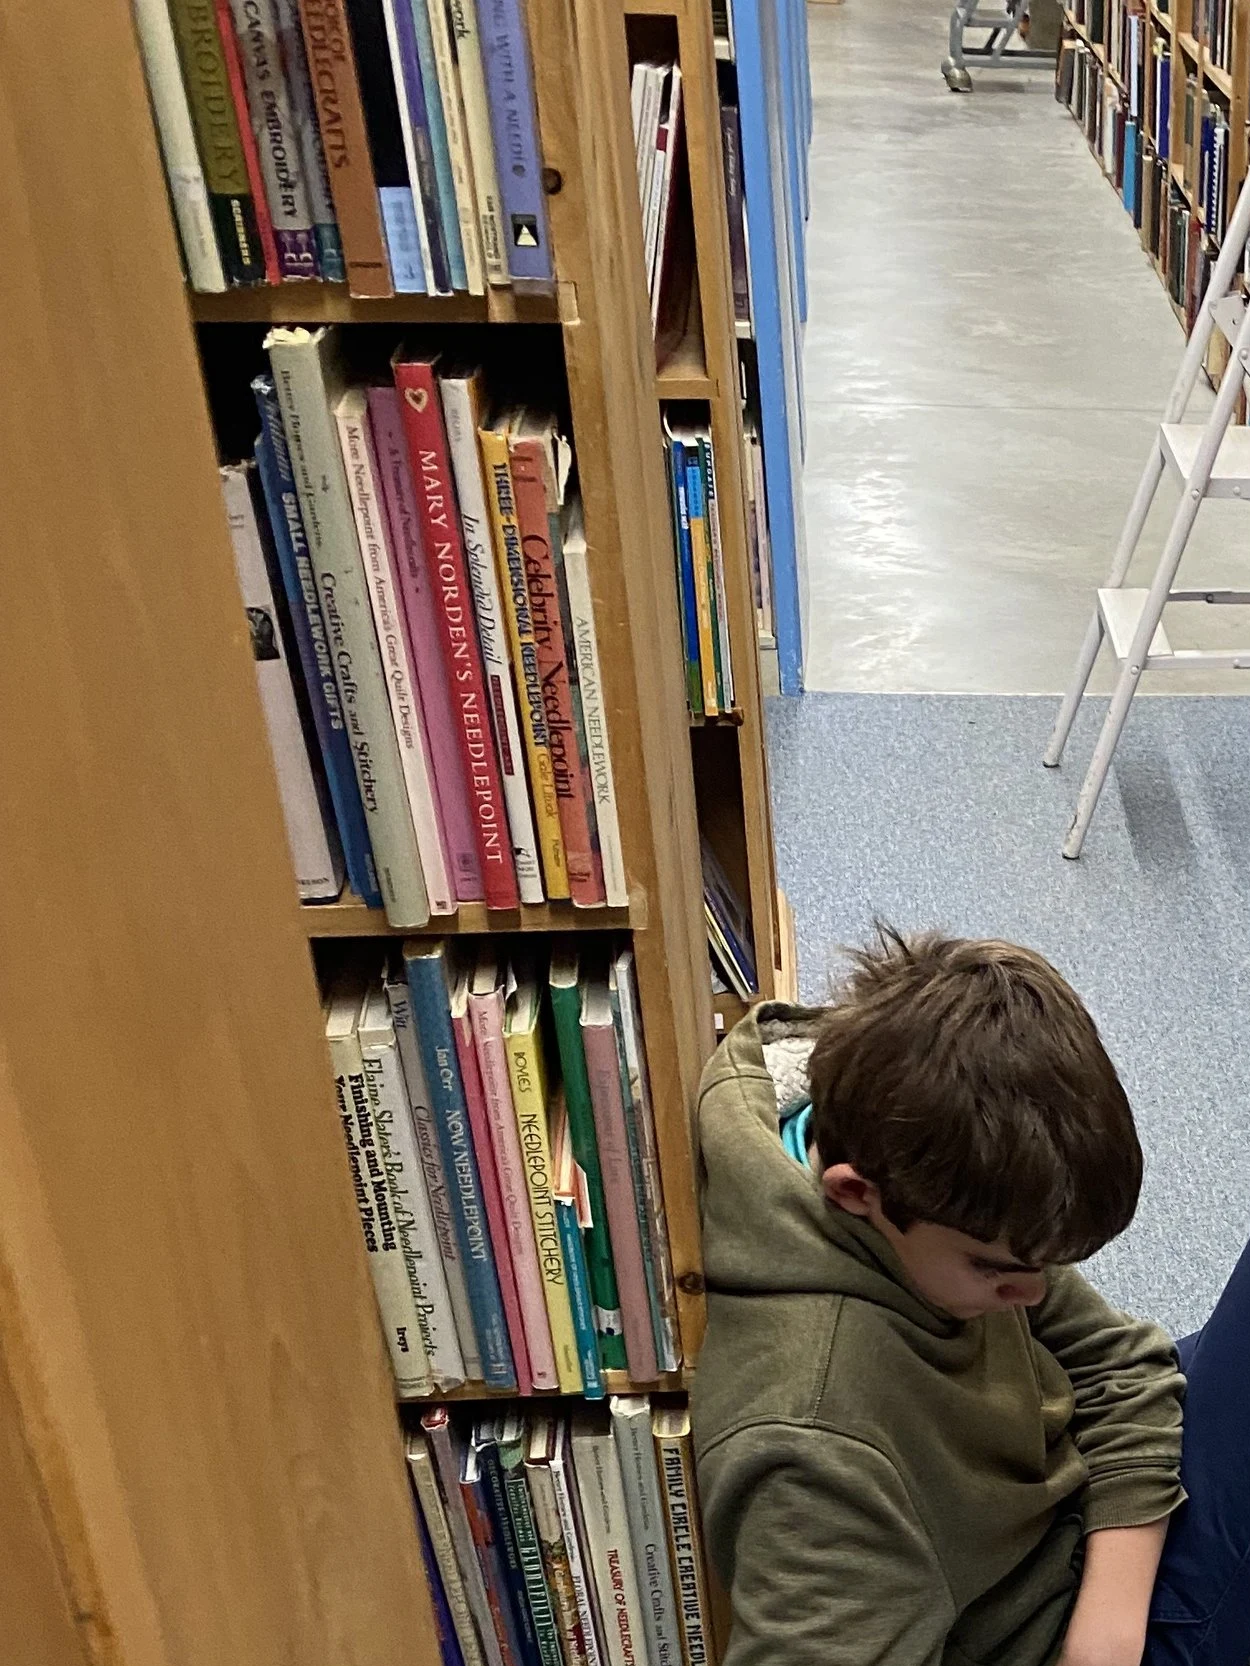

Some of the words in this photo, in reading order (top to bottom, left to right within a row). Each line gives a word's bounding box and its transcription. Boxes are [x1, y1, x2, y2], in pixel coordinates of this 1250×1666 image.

[241, 0, 271, 81] CANVAS
[259, 88, 300, 220] EMBROIDERY
[345, 423, 364, 460] More
[298, 463, 312, 490] and
[350, 461, 378, 541] Needlepoint
[417, 448, 448, 529] MARY
[460, 510, 481, 535] In
[366, 542, 384, 572] from
[464, 537, 497, 614] Splendid
[280, 490, 307, 554] SMALL
[294, 553, 334, 678] NEEDLEWORK
[321, 680, 345, 732] GIFTS
[318, 570, 350, 647] Creative
[372, 573, 395, 632] America's
[432, 541, 474, 685] NORDEN'S
[491, 461, 534, 638] THREE-DIMENSIONAL
[517, 639, 552, 752] NEEDLEPOINT
[518, 531, 562, 653] Celebrity
[384, 632, 402, 667] Great
[476, 611, 505, 668] Detail
[572, 615, 600, 703] AMERICAN
[335, 649, 360, 705] Crafts
[389, 668, 409, 702] Quilt
[347, 707, 364, 736] and
[394, 702, 418, 752] Designs
[536, 656, 583, 801] Needlepoint
[352, 739, 381, 814] Stitchery
[456, 691, 504, 867] NEEDLEPOINT
[583, 704, 613, 805] NEEDLEWORK
[475, 1010, 491, 1037] More
[360, 1054, 389, 1107] Elaine
[433, 1043, 451, 1069] Jan
[438, 1066, 455, 1093] Orr
[329, 1074, 351, 1113] Your
[342, 1071, 379, 1149] Finishing
[372, 1107, 401, 1160] Slater's
[411, 1102, 440, 1161] Classics
[444, 1107, 466, 1150] NOW
[336, 1112, 372, 1205] Needlepoint
[363, 1146, 384, 1177] and
[383, 1161, 408, 1199] Book
[422, 1158, 444, 1186] for
[516, 1111, 555, 1210] NEEDLEPOINT
[357, 1204, 382, 1254] Pieces
[366, 1176, 402, 1251] Mounting
[391, 1196, 412, 1216] of
[427, 1184, 461, 1264] Needlepoint
[451, 1148, 487, 1262] NEEDLEPOINT
[395, 1216, 430, 1301] Needlepoint
[531, 1207, 568, 1289] STITCHERY
[661, 1446, 685, 1500] FAMILY
[669, 1500, 692, 1552] CIRCLE
[570, 1574, 588, 1609] FLORAL
[604, 1548, 625, 1593] TREASURY
[643, 1542, 662, 1587] Creative
[676, 1554, 702, 1622] CREATIVE
[613, 1591, 627, 1608] OF
[649, 1589, 666, 1622] Crafts
[654, 1624, 667, 1641] and
